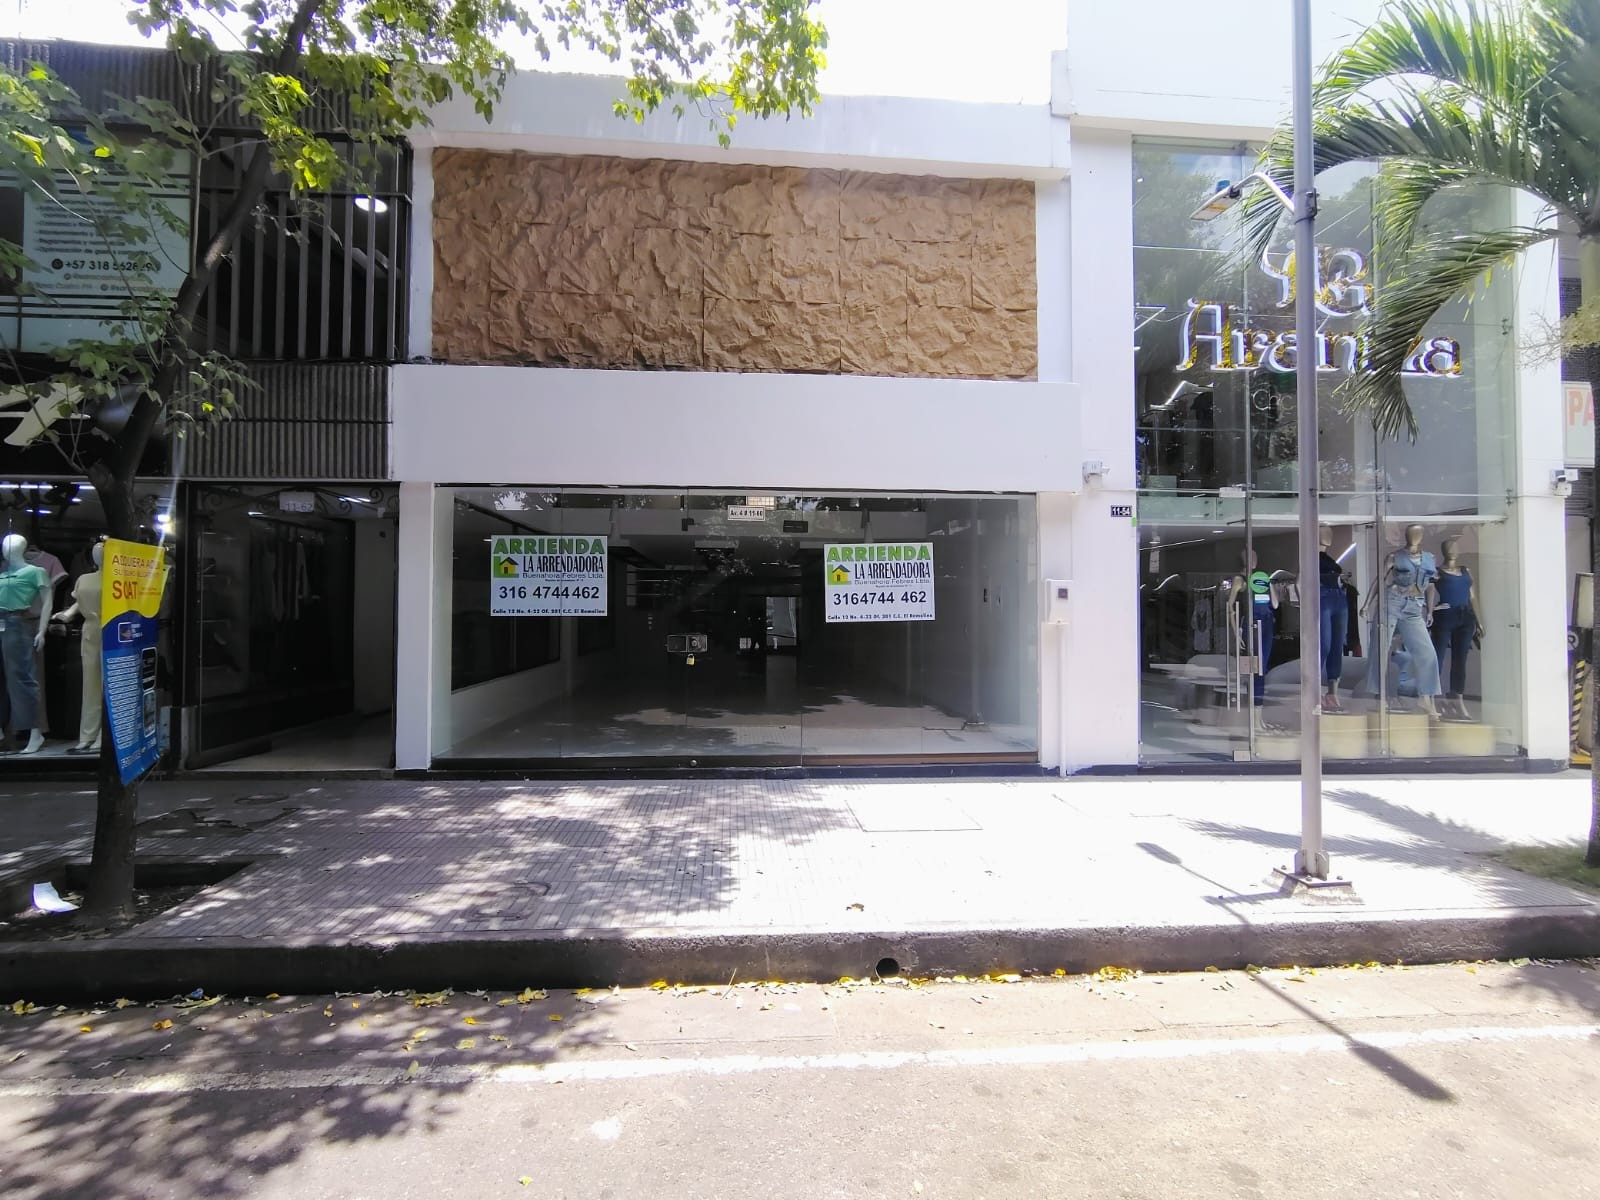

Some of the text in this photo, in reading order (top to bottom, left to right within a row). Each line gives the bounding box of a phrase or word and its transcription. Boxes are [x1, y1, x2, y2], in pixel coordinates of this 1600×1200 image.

[89, 261, 109, 270] 318
[493, 538, 605, 555] ARRIENDA
[826, 545, 931, 562] ARRIENDA
[523, 555, 604, 573] LA ARRENDADORA
[855, 562, 931, 580] LA ARRENDADORA
[499, 586, 527, 599] 316
[833, 591, 927, 606] 3164744 462
